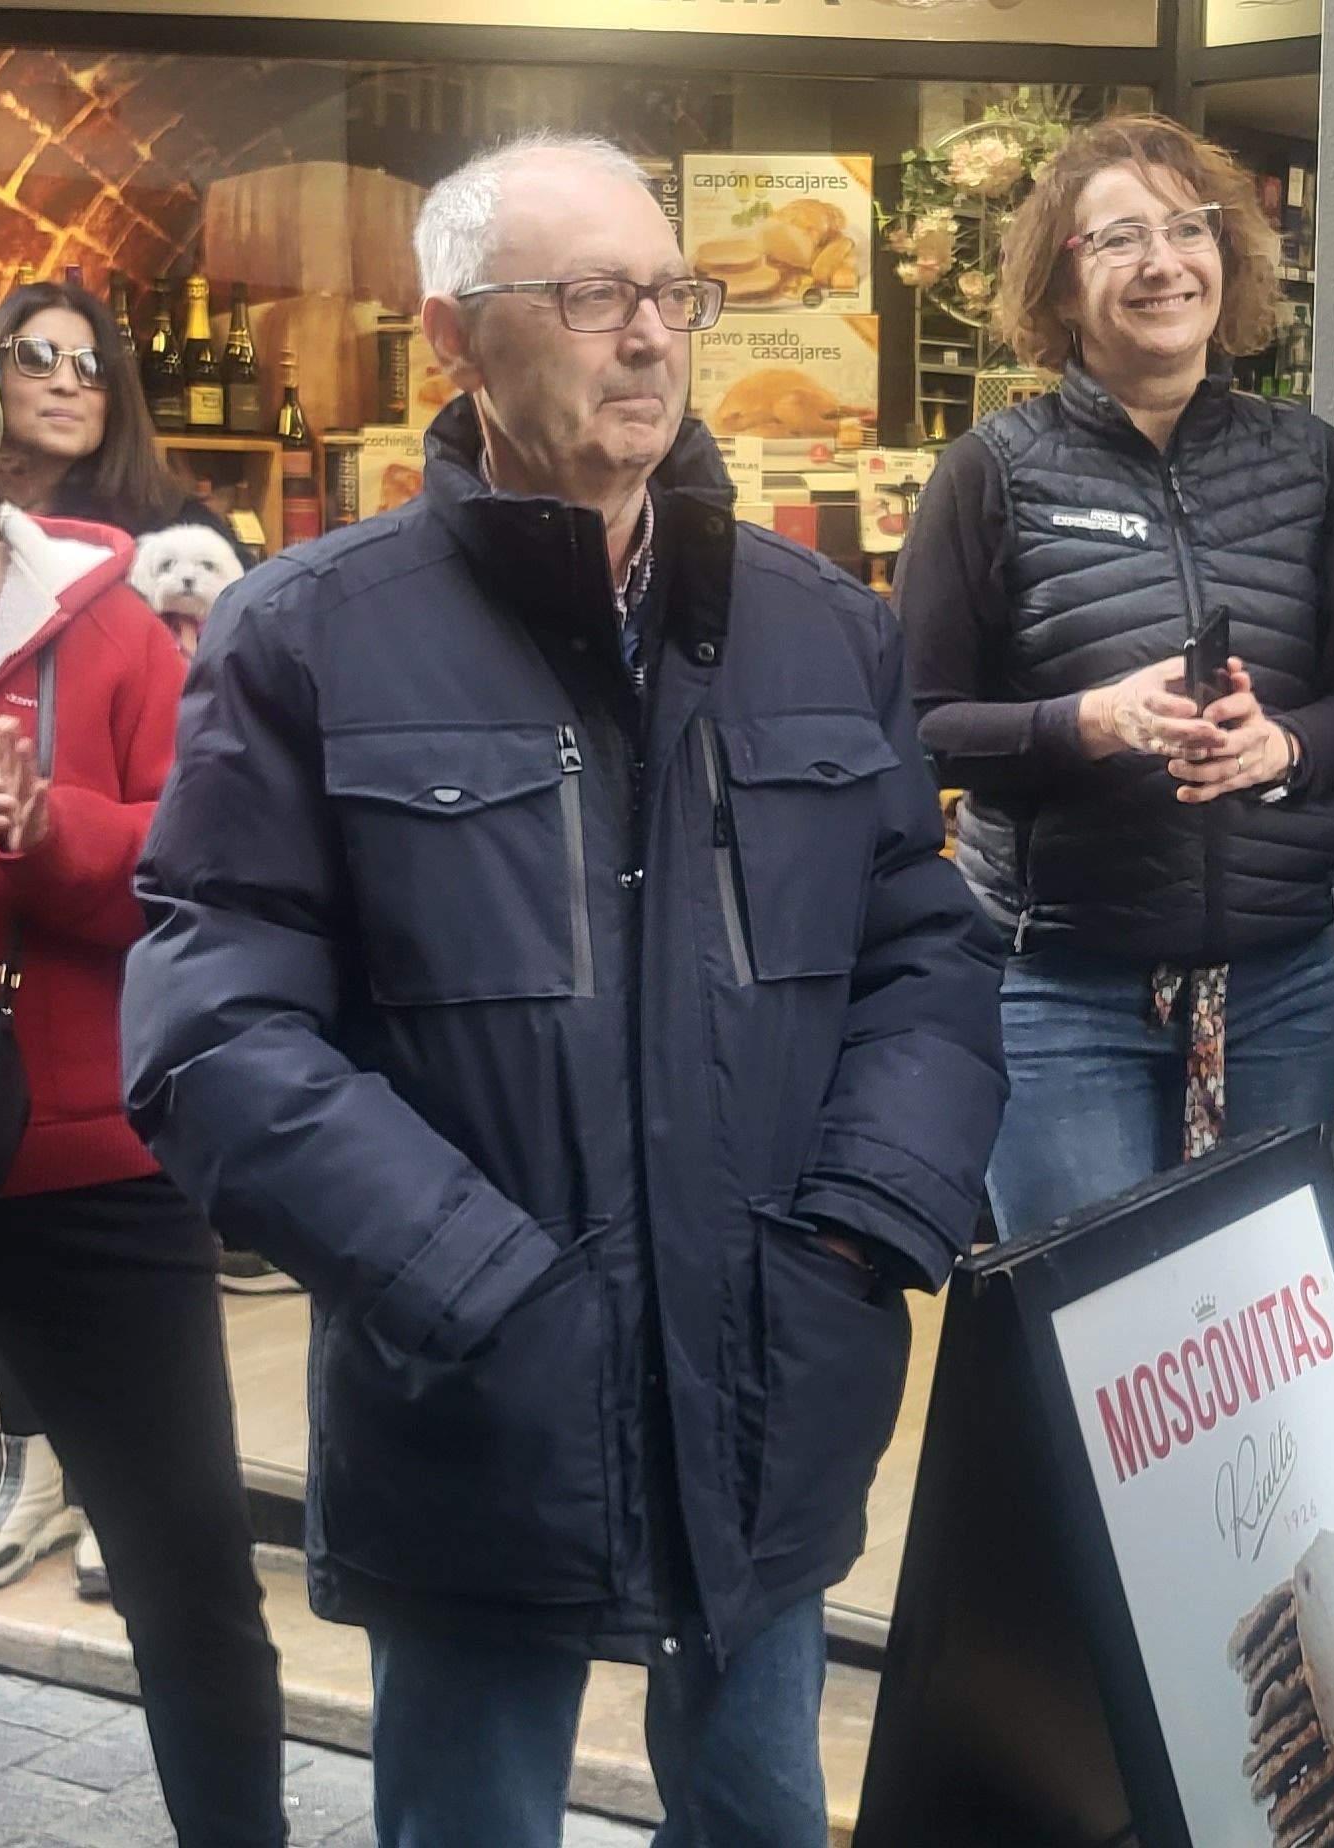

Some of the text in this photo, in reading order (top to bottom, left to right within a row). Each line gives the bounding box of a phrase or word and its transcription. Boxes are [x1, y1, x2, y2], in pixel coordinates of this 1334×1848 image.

[693, 171, 750, 193] capón
[754, 172, 848, 193] cascajares
[700, 328, 800, 349] pavo asado
[751, 345, 841, 364] cascajares
[1094, 1272, 1334, 1485] MOSCOVITAS
[1214, 1420, 1298, 1563] Rialto
[1282, 1498, 1318, 1534] 1926
